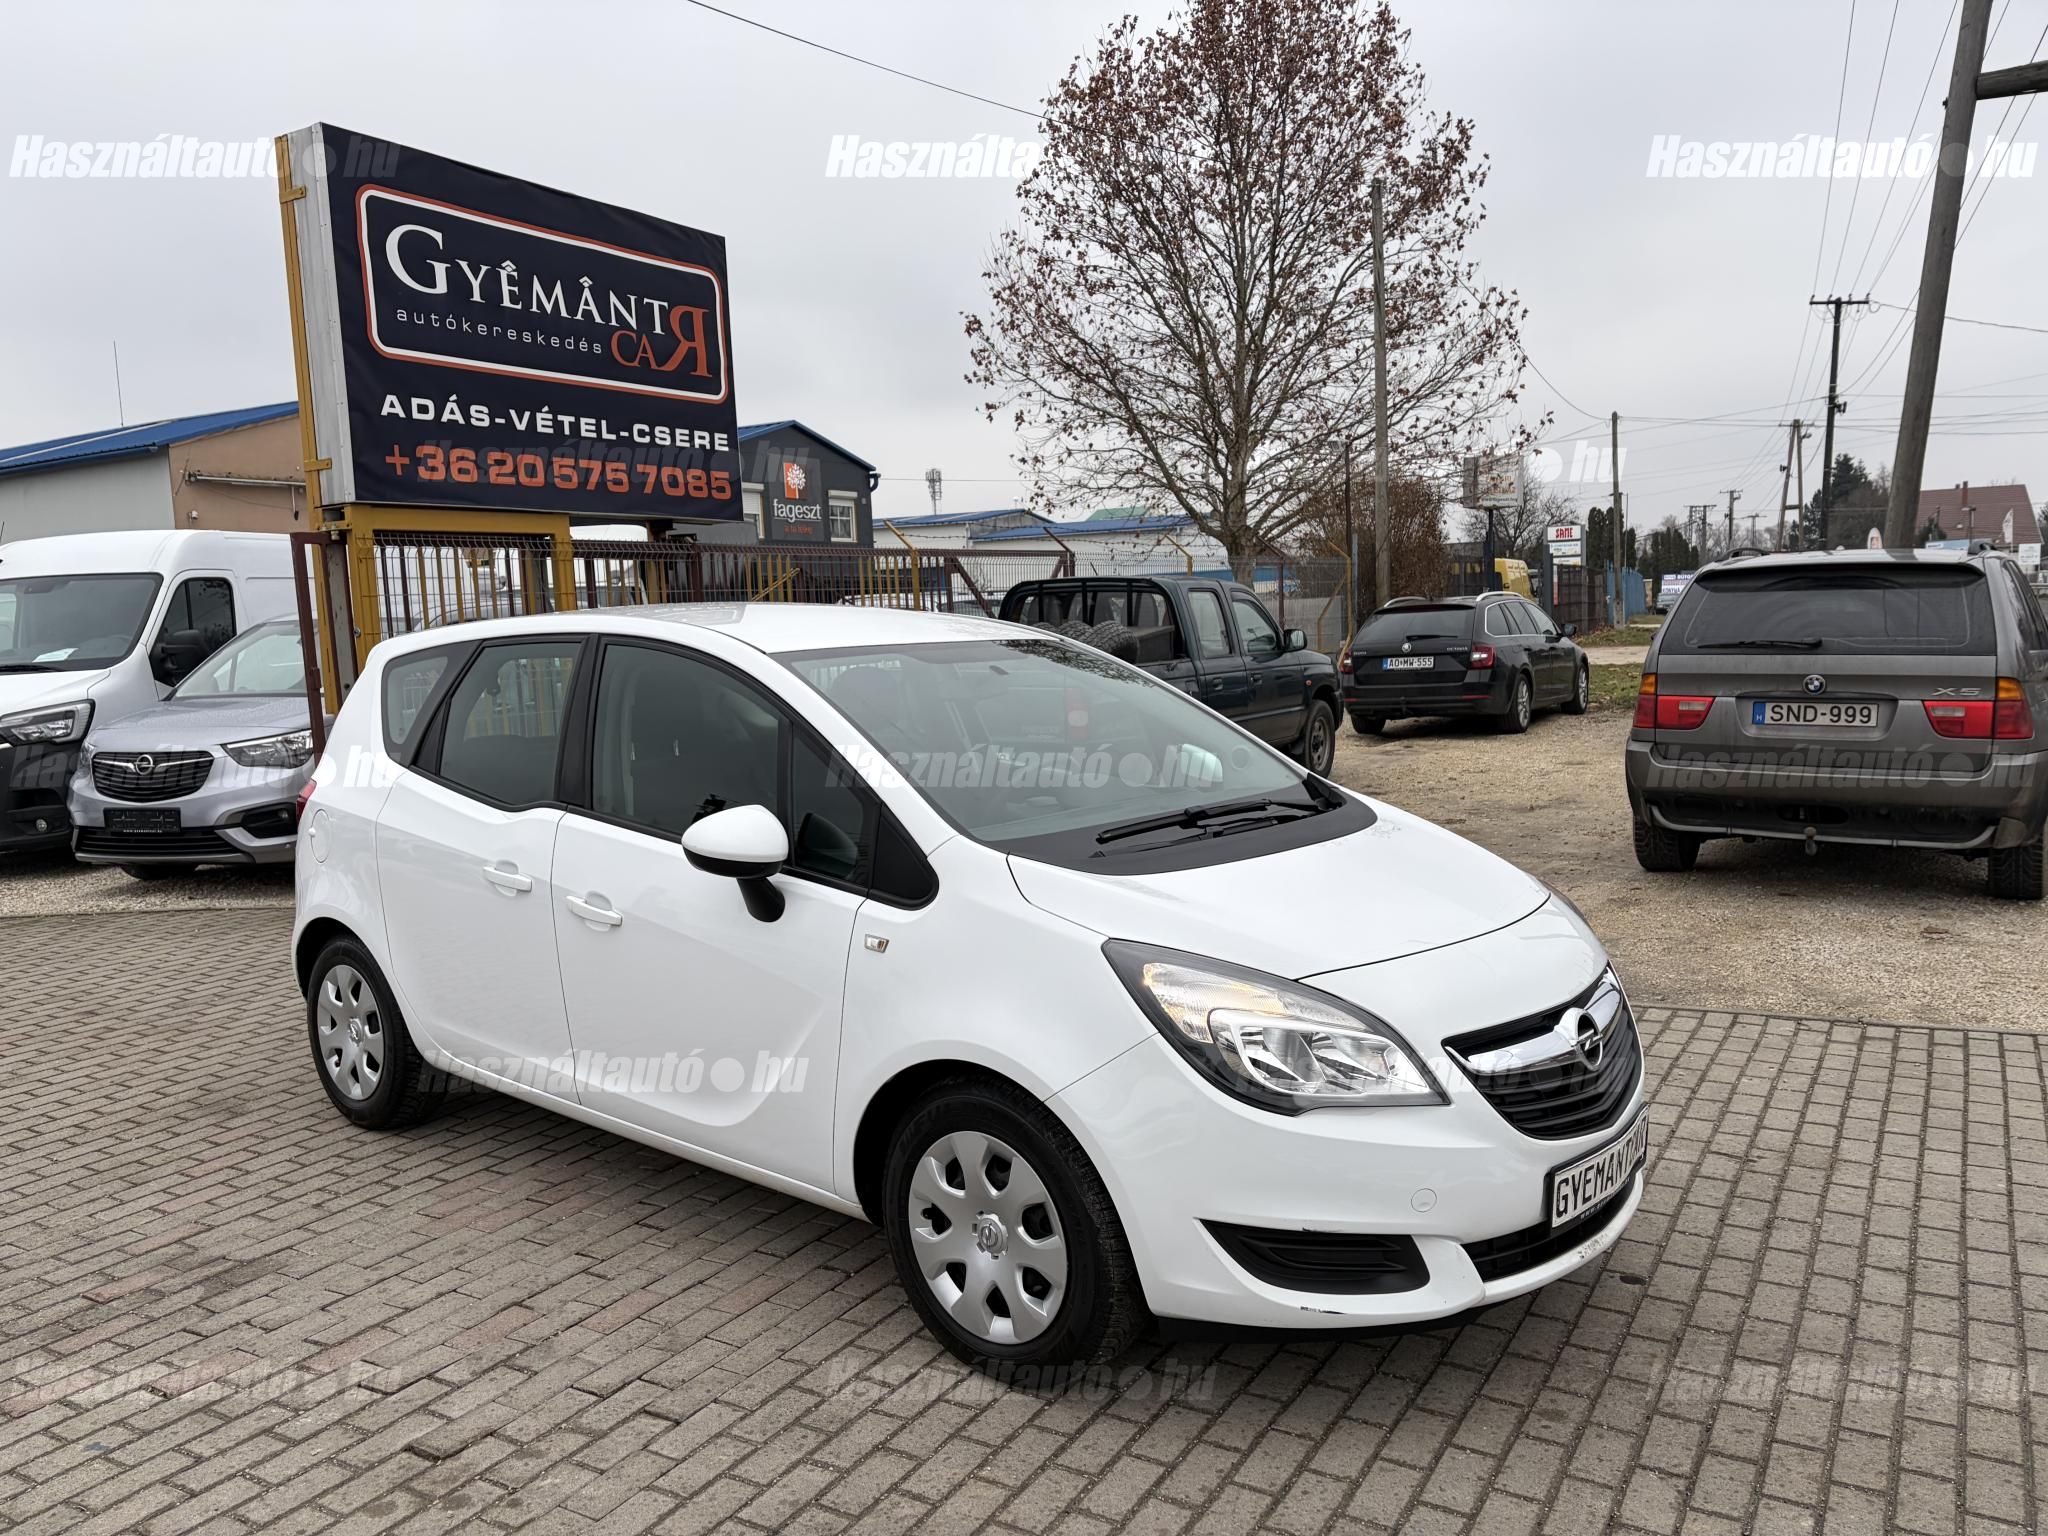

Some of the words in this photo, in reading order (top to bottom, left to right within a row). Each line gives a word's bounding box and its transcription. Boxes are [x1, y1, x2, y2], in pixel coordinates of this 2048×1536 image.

[396, 307, 602, 354] autókereskedés
[773, 499, 822, 523] fageszt
[1555, 527, 1573, 538] SAME
[1932, 687, 1982, 696] X5
[1769, 704, 1873, 724] SND-999
